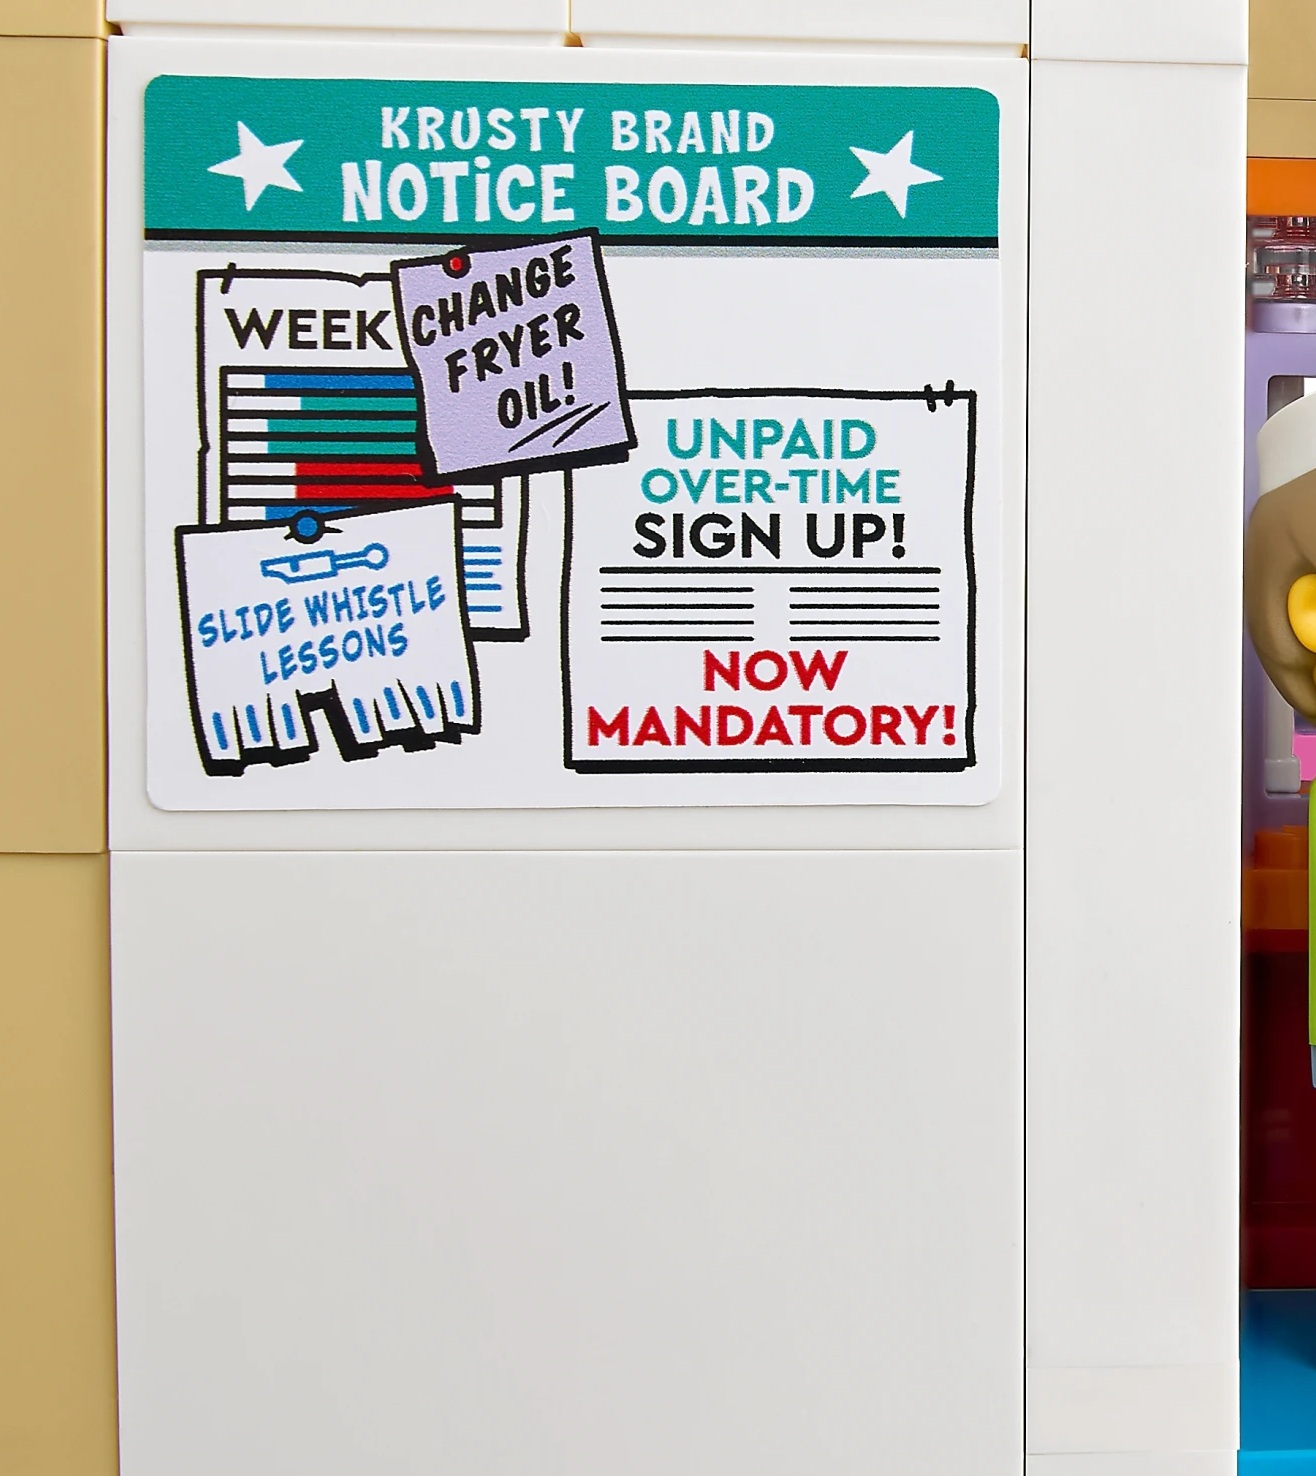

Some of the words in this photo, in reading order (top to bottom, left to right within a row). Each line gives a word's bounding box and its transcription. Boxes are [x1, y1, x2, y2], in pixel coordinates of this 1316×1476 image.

[381, 106, 584, 152] KRUSTY
[611, 110, 775, 154] BRAND
[605, 165, 814, 226] BOARD
[412, 245, 577, 347] CHANGE
[224, 308, 393, 350] WEEK
[444, 304, 584, 393] FRYER
[498, 361, 575, 429] OIL!
[666, 418, 877, 460] UNPAID
[640, 468, 901, 504] OVER-TIME
[632, 512, 780, 559] SIGN
[806, 512, 906, 559] UP!
[198, 597, 295, 648] SLIDE
[304, 575, 446, 627] WHISTLE
[260, 622, 409, 685] LESSONS
[703, 650, 849, 692] NOW
[587, 704, 956, 746] MANDATORY!
